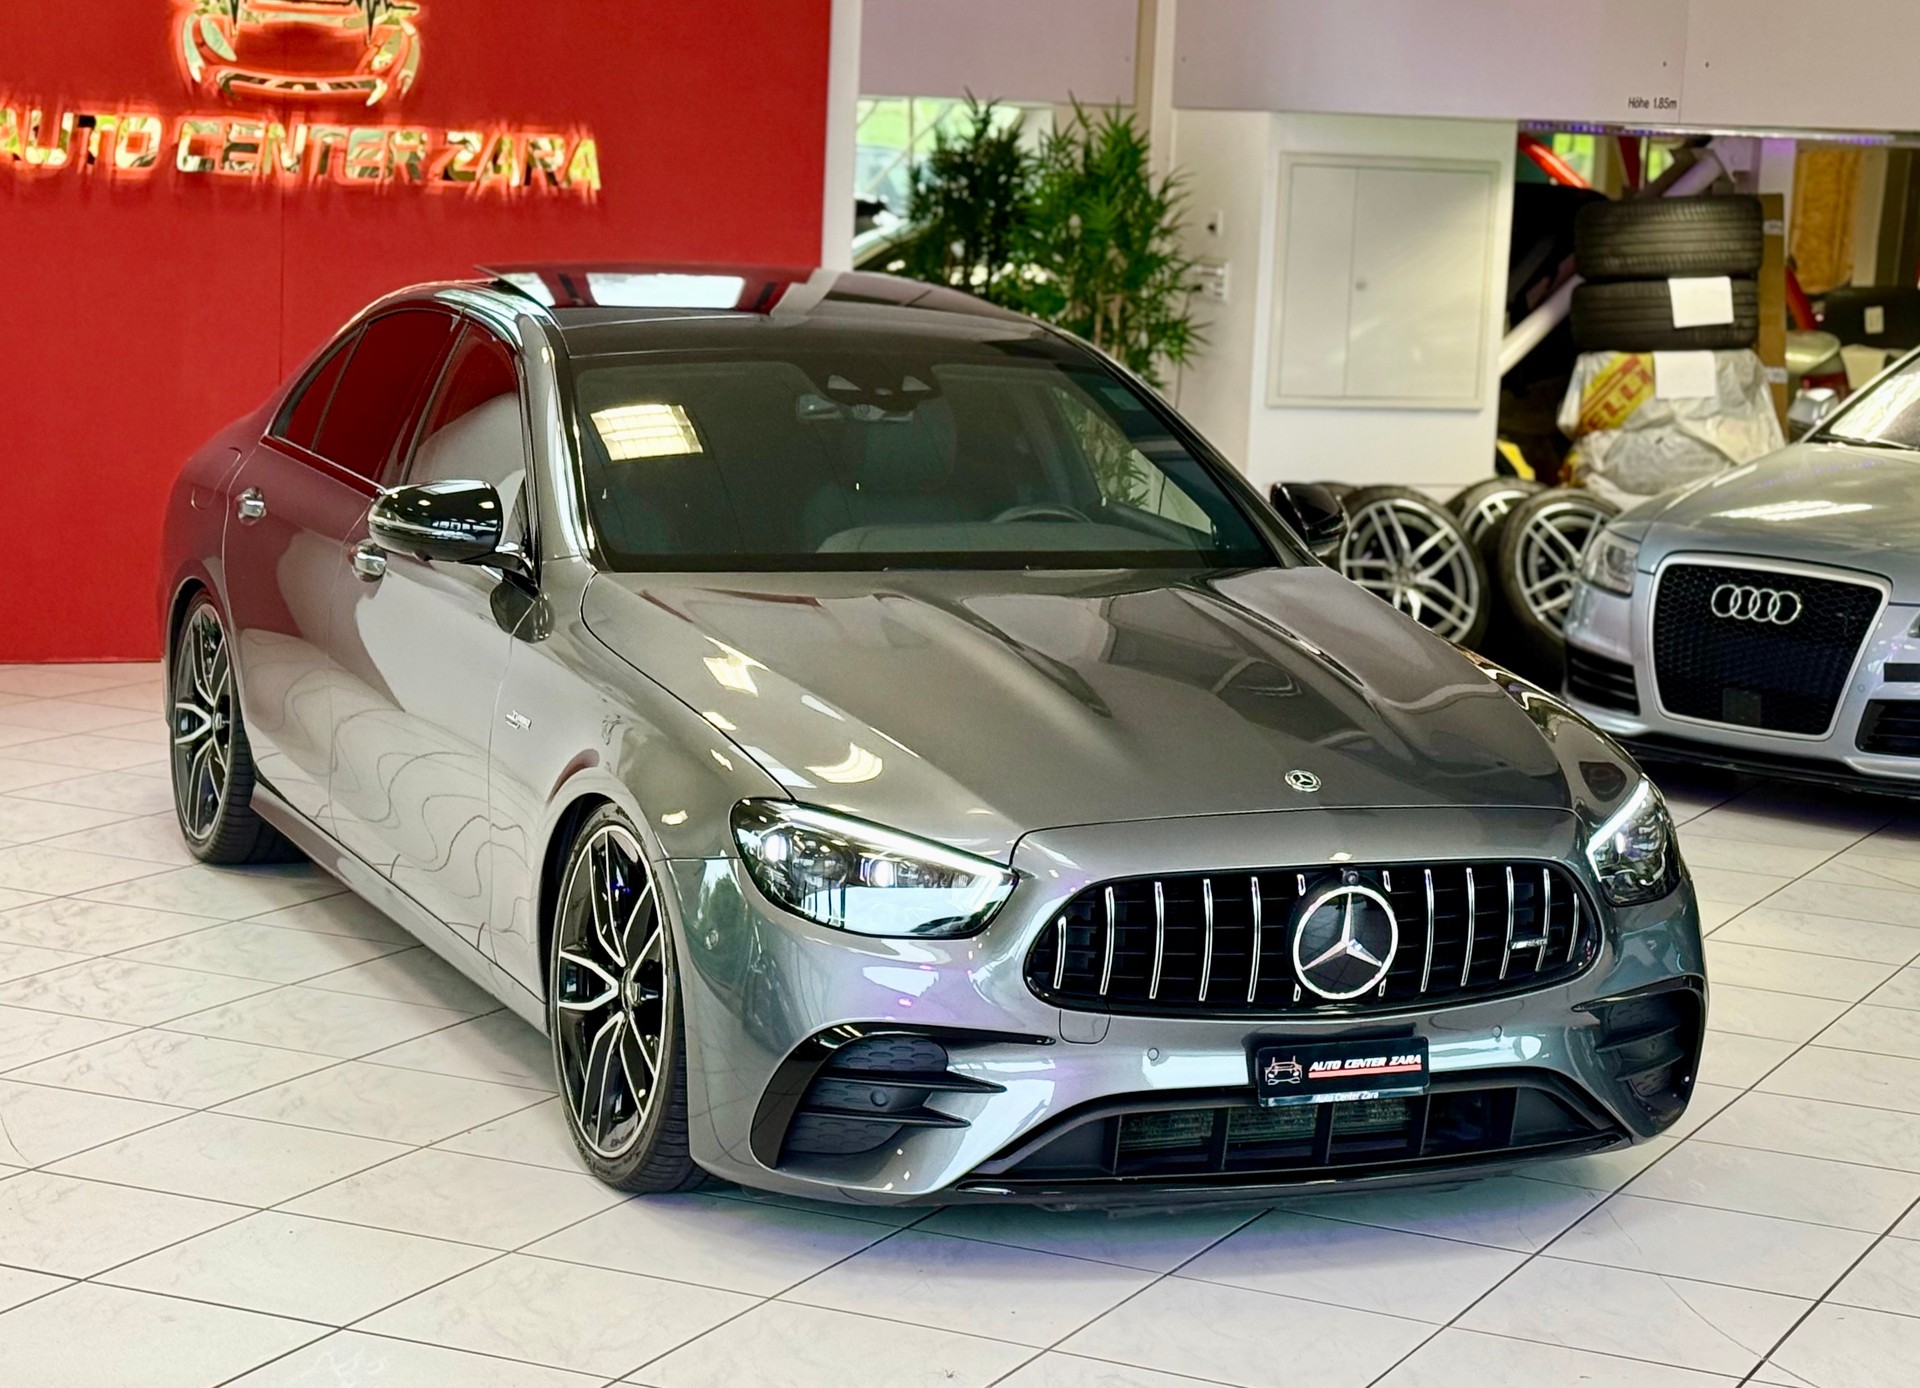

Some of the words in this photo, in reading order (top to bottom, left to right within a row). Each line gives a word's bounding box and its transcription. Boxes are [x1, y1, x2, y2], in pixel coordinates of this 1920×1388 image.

[1628, 96, 1650, 110] Höhe
[1653, 96, 1678, 110] 1.85m
[176, 119, 429, 182] CENTER
[434, 130, 601, 190] ZARA
[1309, 1061, 1342, 1072] AUTO
[1344, 1057, 1387, 1069] CENTER
[1389, 1054, 1422, 1066] ZARA
